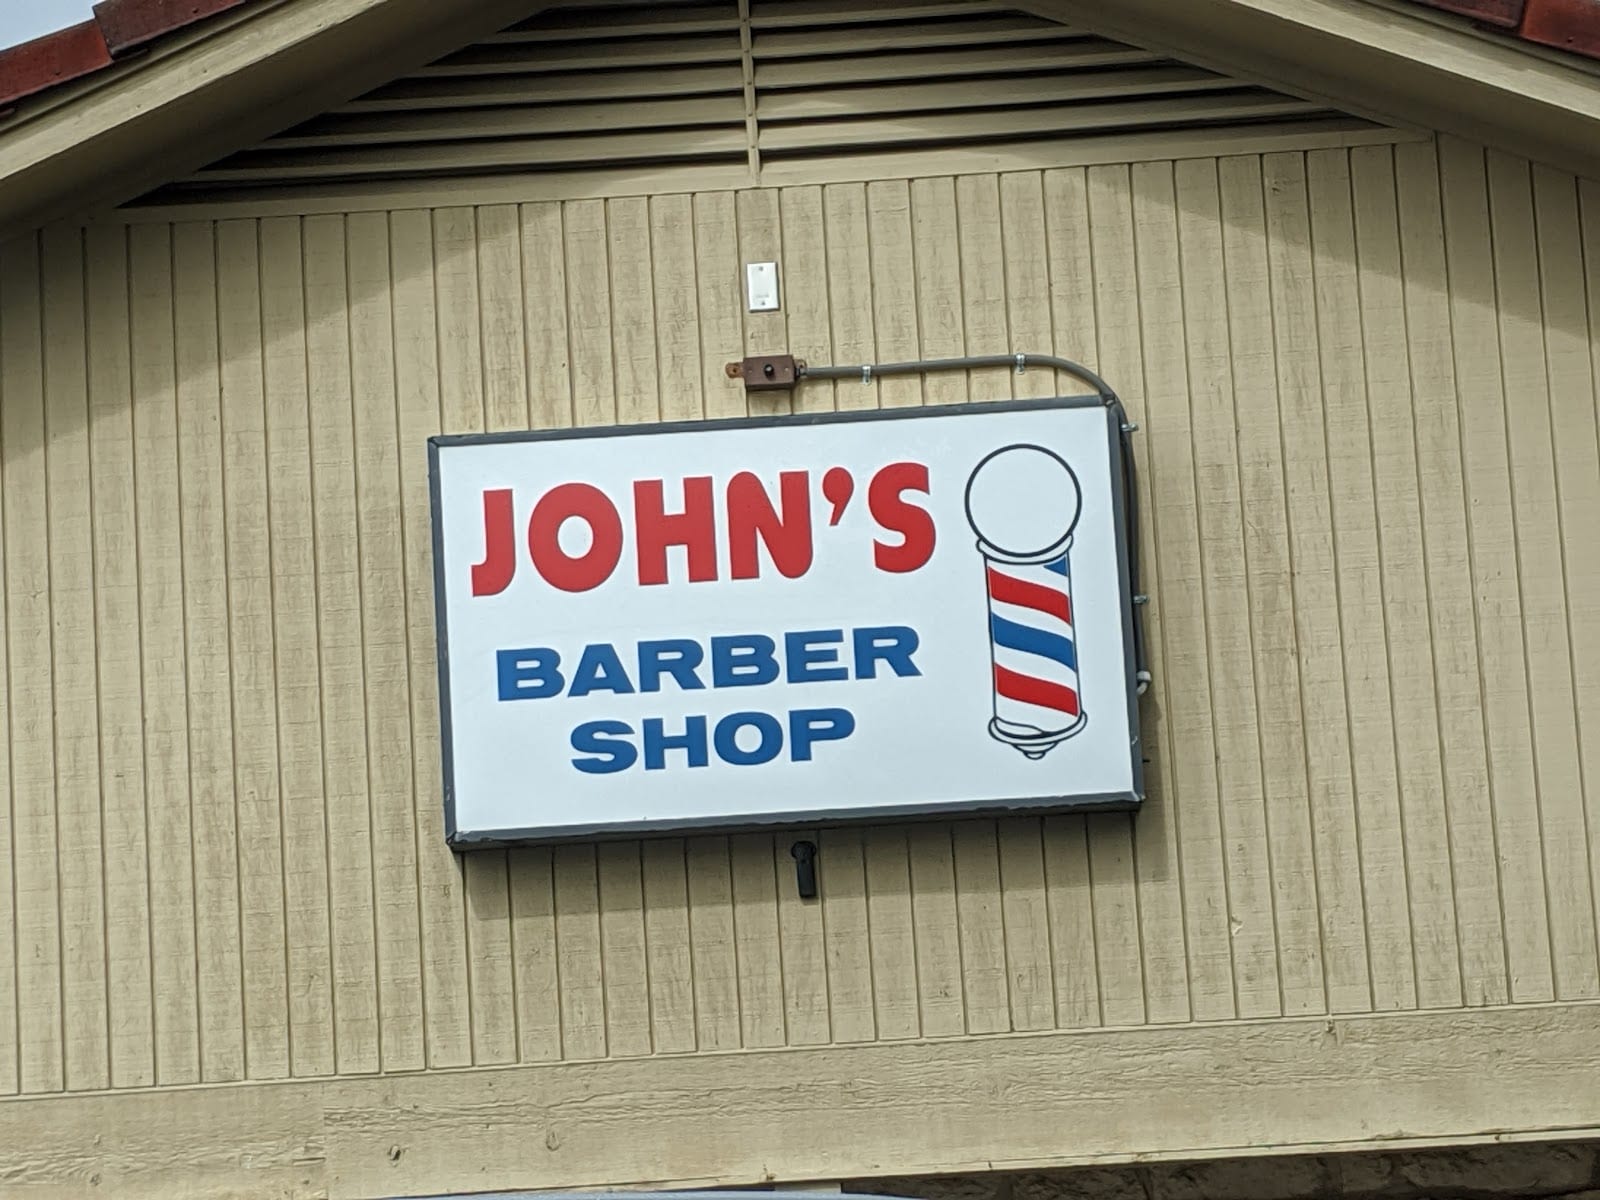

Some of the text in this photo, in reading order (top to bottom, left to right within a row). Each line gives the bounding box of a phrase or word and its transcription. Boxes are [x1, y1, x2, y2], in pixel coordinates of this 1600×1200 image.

[471, 462, 936, 596] JOHN'S
[496, 626, 921, 701] BARBER
[570, 708, 856, 774] SHOP
